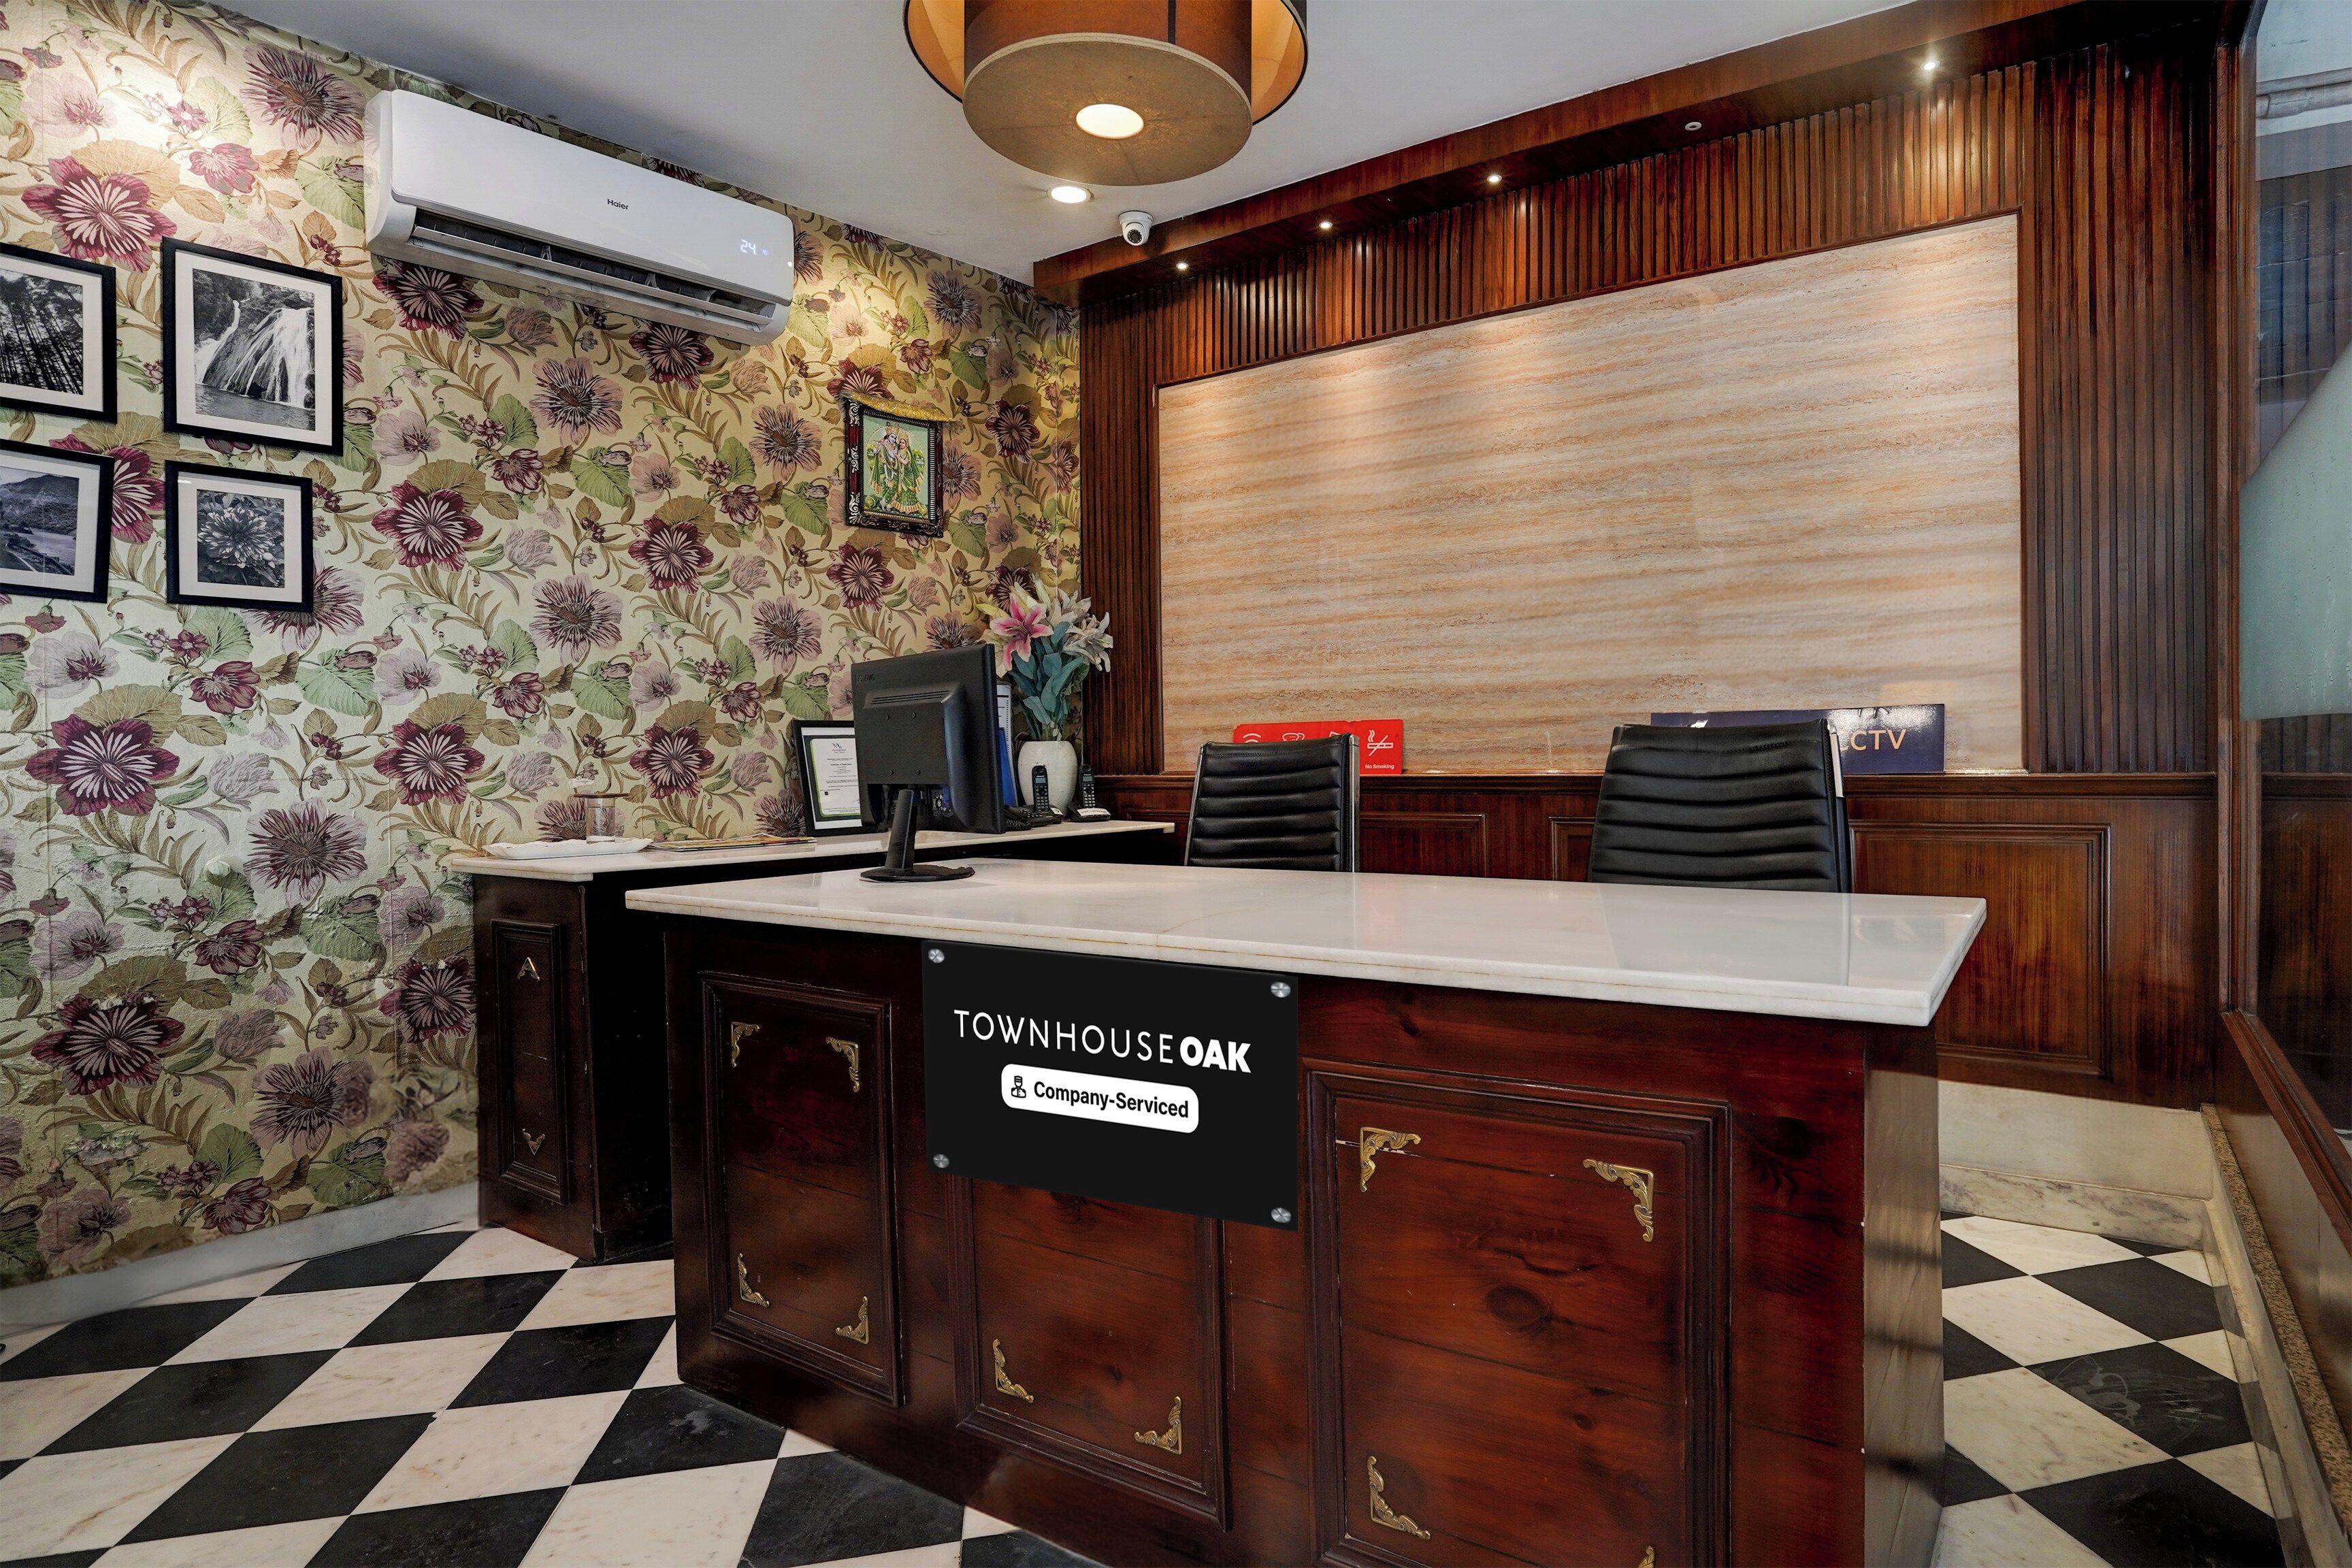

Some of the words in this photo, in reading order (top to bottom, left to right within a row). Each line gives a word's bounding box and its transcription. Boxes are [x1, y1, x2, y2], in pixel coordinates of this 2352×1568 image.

[607, 198, 629, 210] Haier
[740, 239, 757, 255] 24
[1840, 729, 1907, 751] CTV
[953, 1009, 1173, 1064] TOWNHOUSE
[1179, 1035, 1252, 1074] OAK
[1033, 1080, 1189, 1119] Company-Serviced
